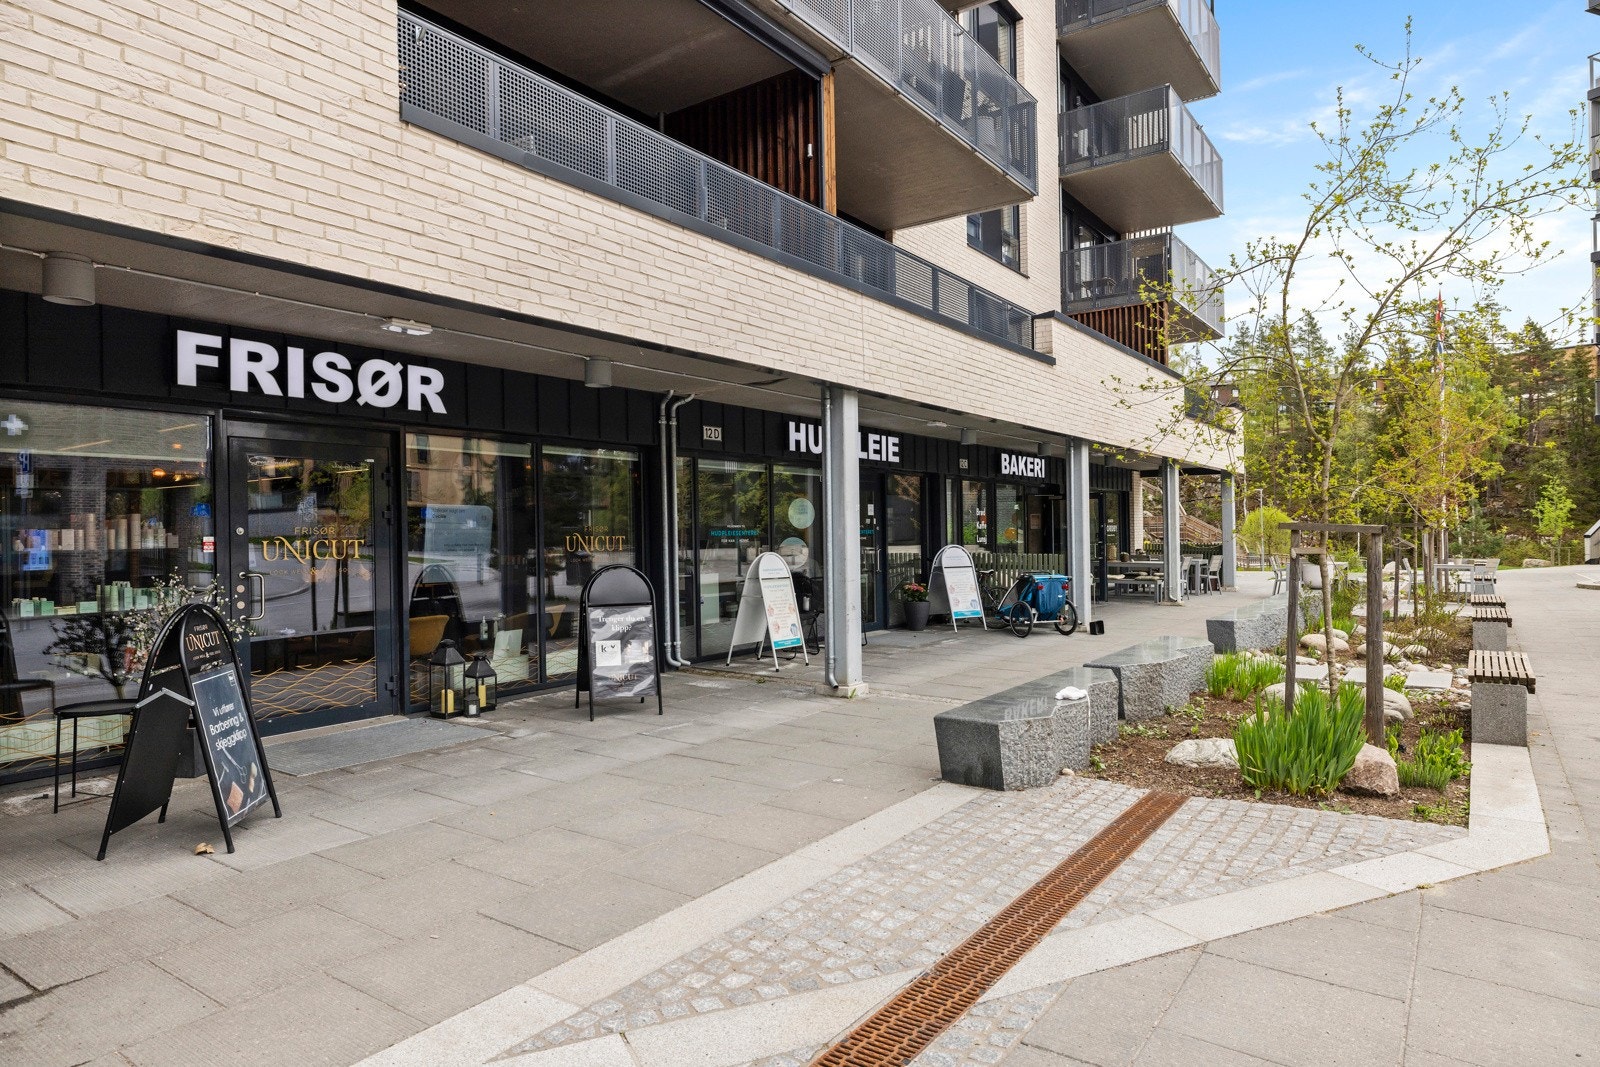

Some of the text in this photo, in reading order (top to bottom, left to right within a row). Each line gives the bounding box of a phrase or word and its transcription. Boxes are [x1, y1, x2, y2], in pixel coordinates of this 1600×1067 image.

[176, 330, 448, 414] FRISØR
[704, 427, 720, 439] 12D
[788, 420, 899, 463] HULEIE
[1001, 453, 1045, 478] BAKERI
[294, 526, 335, 535] FRISØR
[262, 536, 364, 565] UNICUT
[565, 532, 626, 556] UNICUT
[598, 615, 624, 623] Trenger
[186, 631, 220, 652] UNICUT
[209, 712, 245, 736] Barbering &
[215, 728, 248, 752] skjeggklipp
